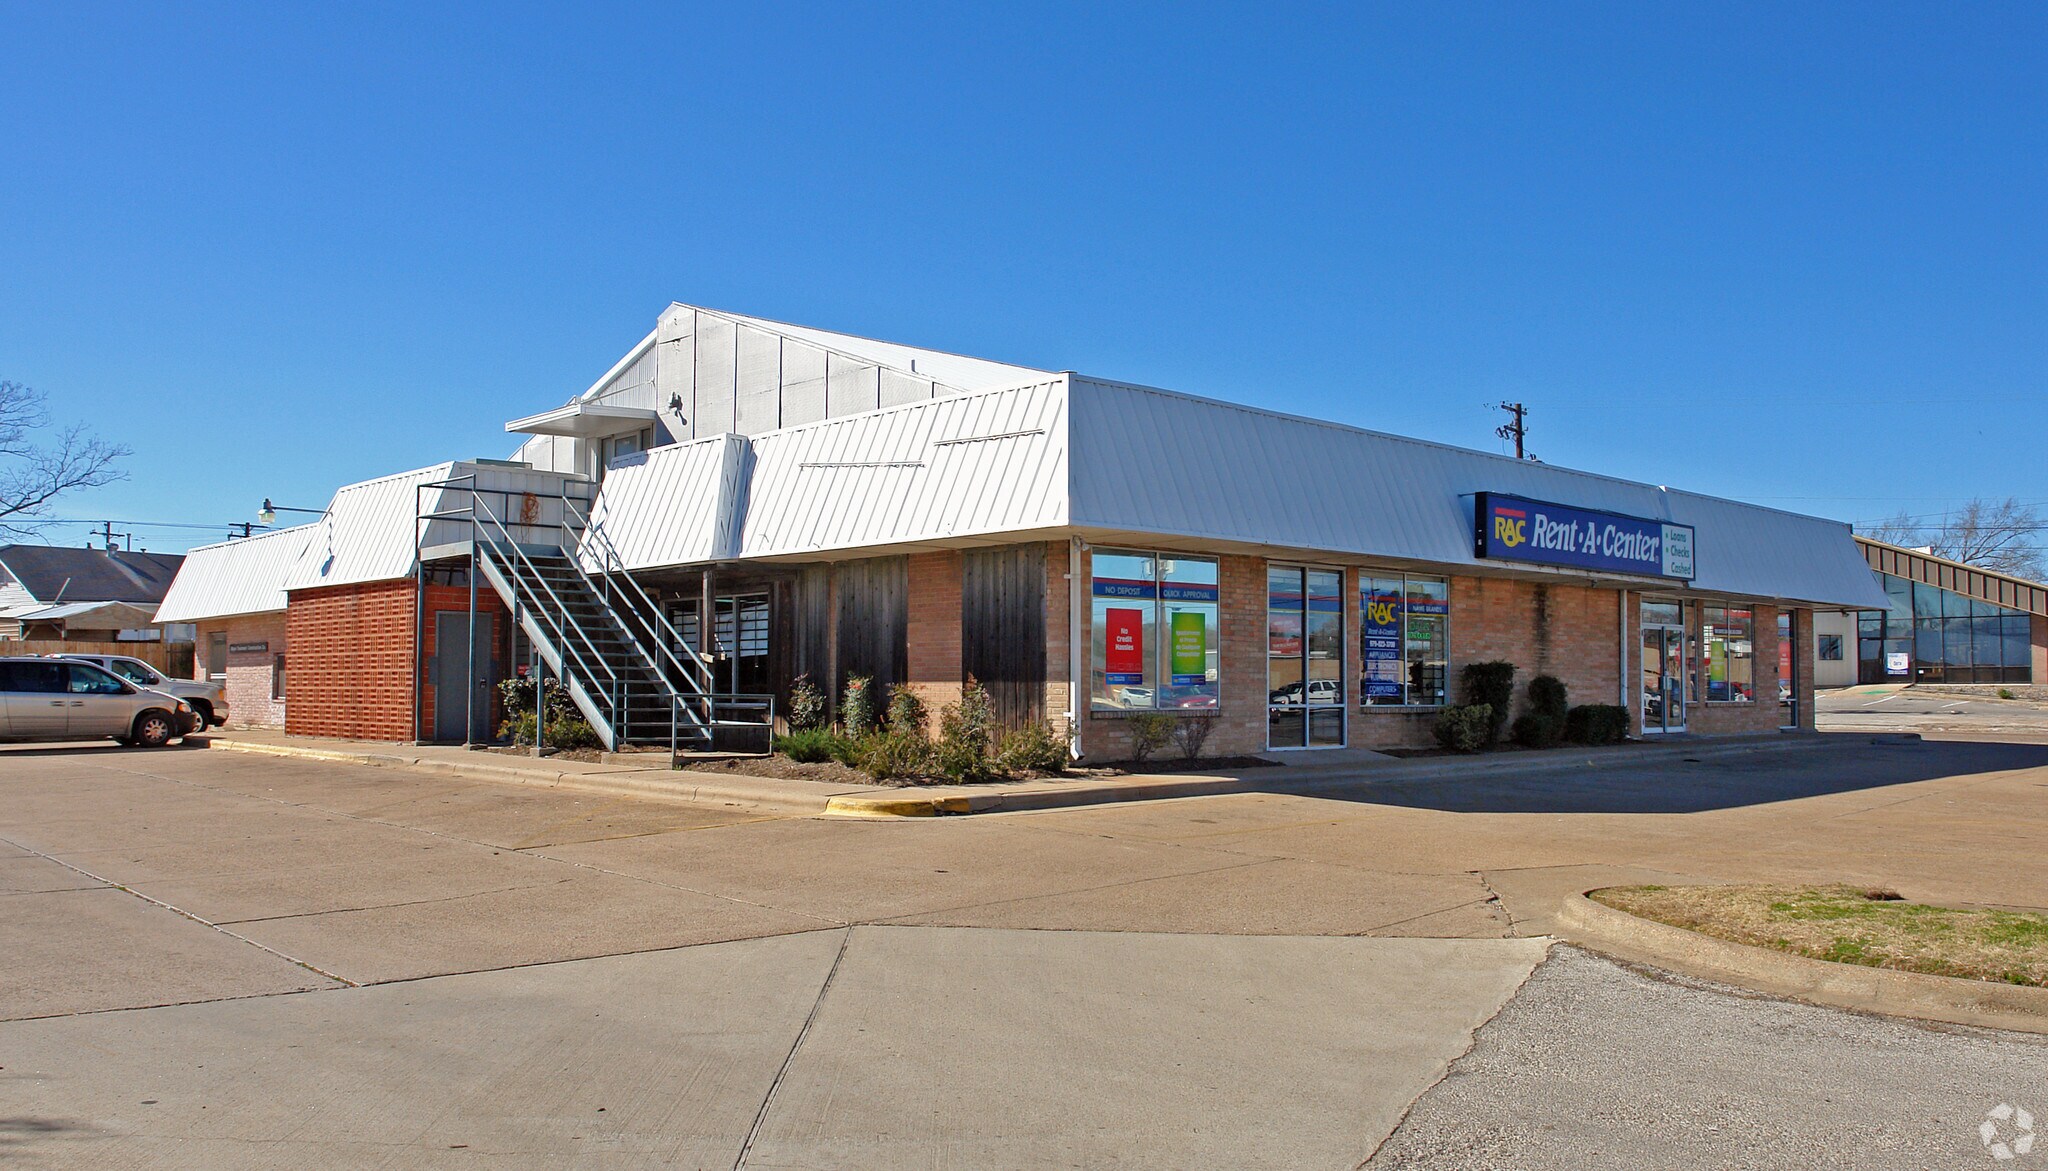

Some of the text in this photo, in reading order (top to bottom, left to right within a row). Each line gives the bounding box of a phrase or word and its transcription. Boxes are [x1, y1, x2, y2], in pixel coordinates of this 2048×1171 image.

[1495, 516, 1526, 548] RAC
[1671, 529, 1686, 542] Loans
[1671, 545, 1689, 558] Checks
[1671, 561, 1691, 575] Cashed
[1105, 586, 1141, 595] NO DEPOSIT
[1163, 590, 1211, 599] QUICK APPROVAL
[1368, 602, 1396, 625] RAC
